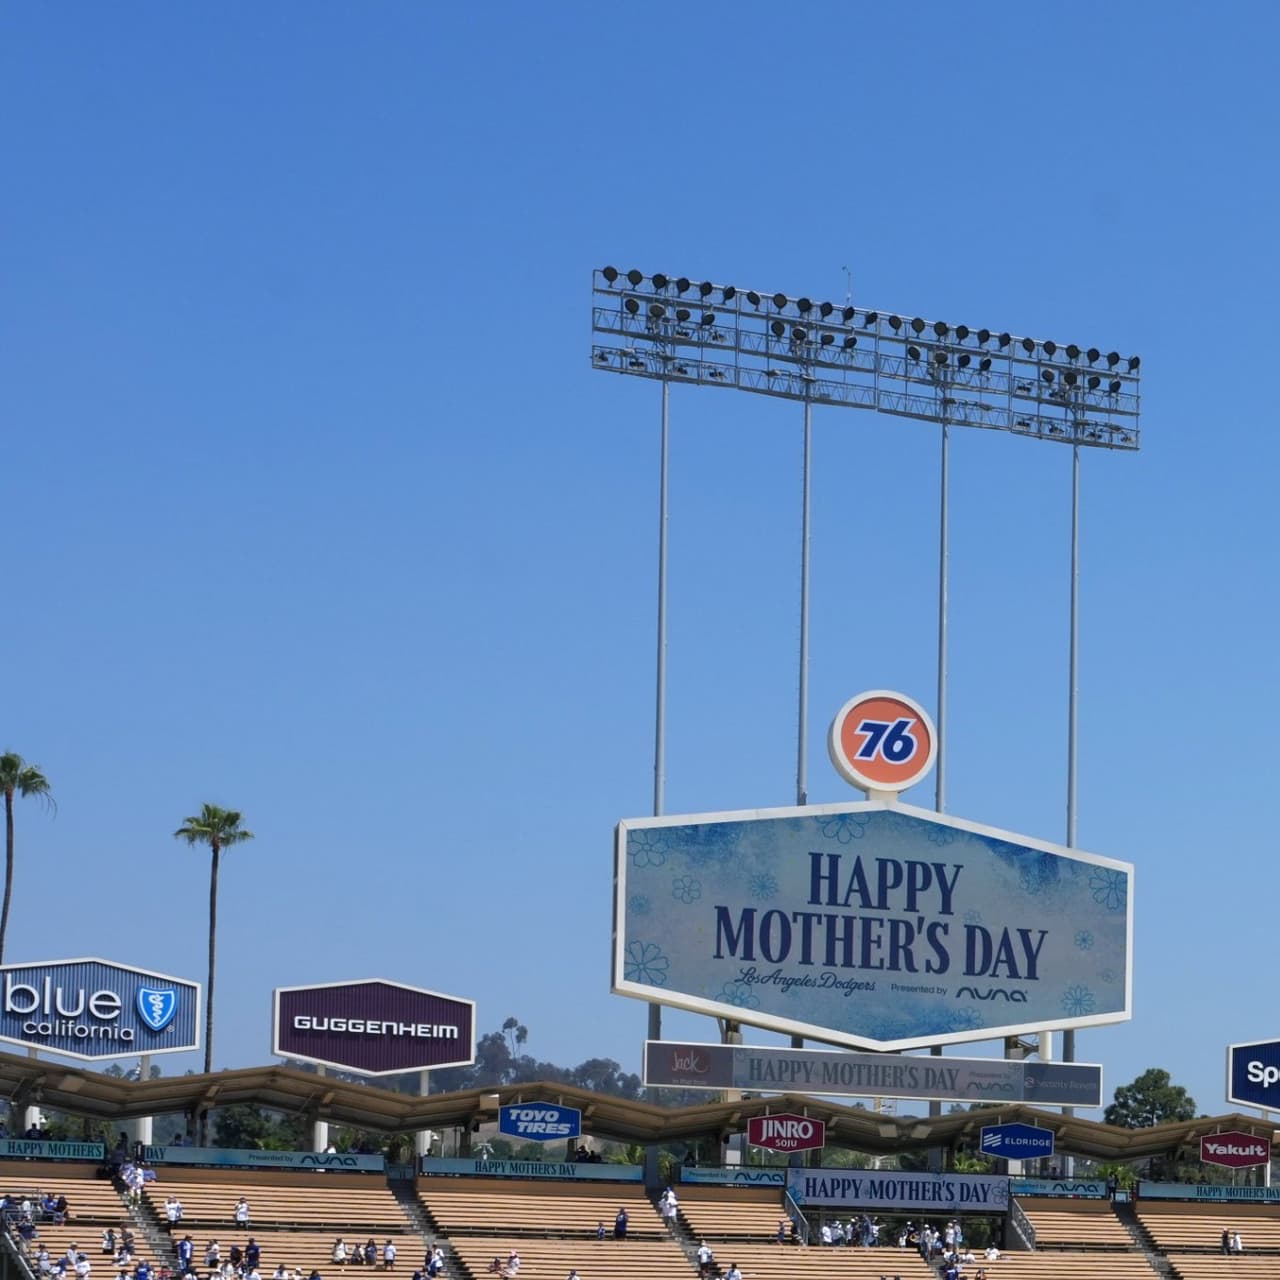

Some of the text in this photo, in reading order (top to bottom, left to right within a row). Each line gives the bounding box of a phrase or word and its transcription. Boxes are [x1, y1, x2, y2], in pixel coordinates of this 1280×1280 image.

[854, 717, 918, 764] 76
[808, 852, 964, 915] HAPPY
[713, 904, 1049, 981] MOTHER'S DAY
[734, 966, 877, 998] Los Angeles Dodgers
[891, 983, 948, 997] Presented by
[5, 972, 123, 1020] blue
[23, 1018, 136, 1041] california
[293, 1015, 460, 1040] GUGGENHEIM
[671, 1052, 702, 1073] Jack
[748, 1057, 816, 1084] HAPPY
[821, 1061, 921, 1090] MOTHER'S
[923, 1067, 960, 1091] DAY
[508, 1108, 560, 1122] TOYO
[516, 1121, 572, 1136] TIRES
[761, 1120, 814, 1143] JINRO
[7, 1141, 167, 1161] HAPPY MOTHER'S DAY
[775, 1139, 798, 1148] SOJU
[1004, 1136, 1052, 1148] ELDRIDGE
[1205, 1142, 1267, 1157] Yakult
[474, 1160, 578, 1177] HAPPY MOTHER'S DAY
[804, 1177, 864, 1200] HAPPY
[869, 1179, 955, 1202] MOTHER'S
[959, 1182, 993, 1203] DAY
